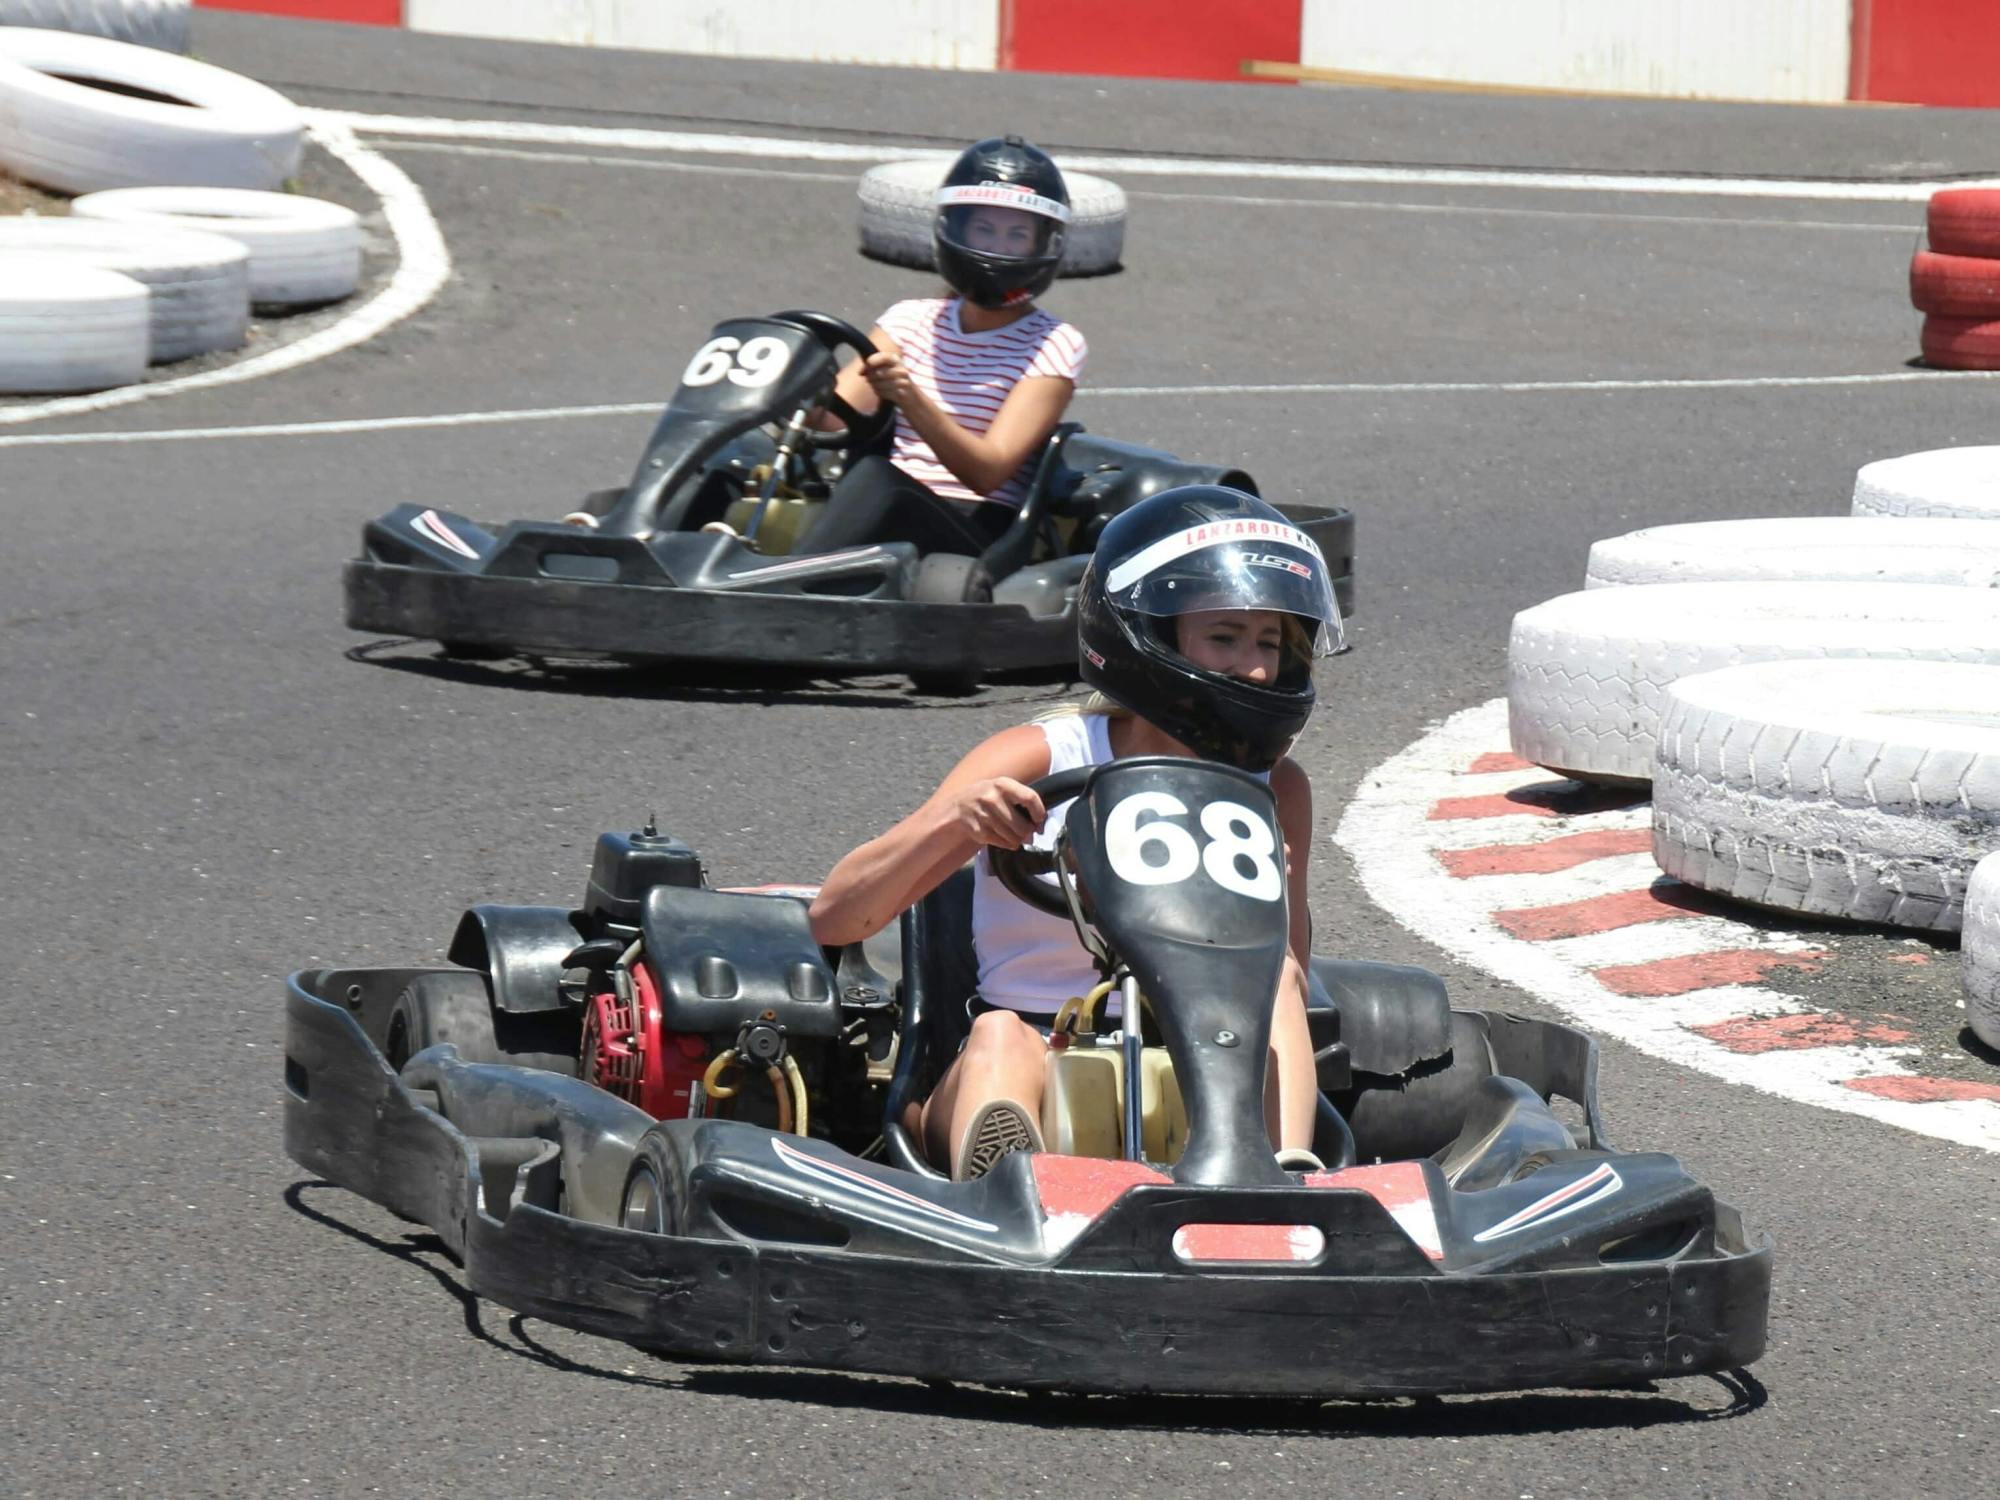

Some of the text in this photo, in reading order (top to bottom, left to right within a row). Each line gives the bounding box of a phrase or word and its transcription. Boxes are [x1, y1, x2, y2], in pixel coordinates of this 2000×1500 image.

[682, 336, 790, 388] 69
[1186, 521, 1290, 546] LANZAROTE
[1105, 791, 1282, 902] 68
